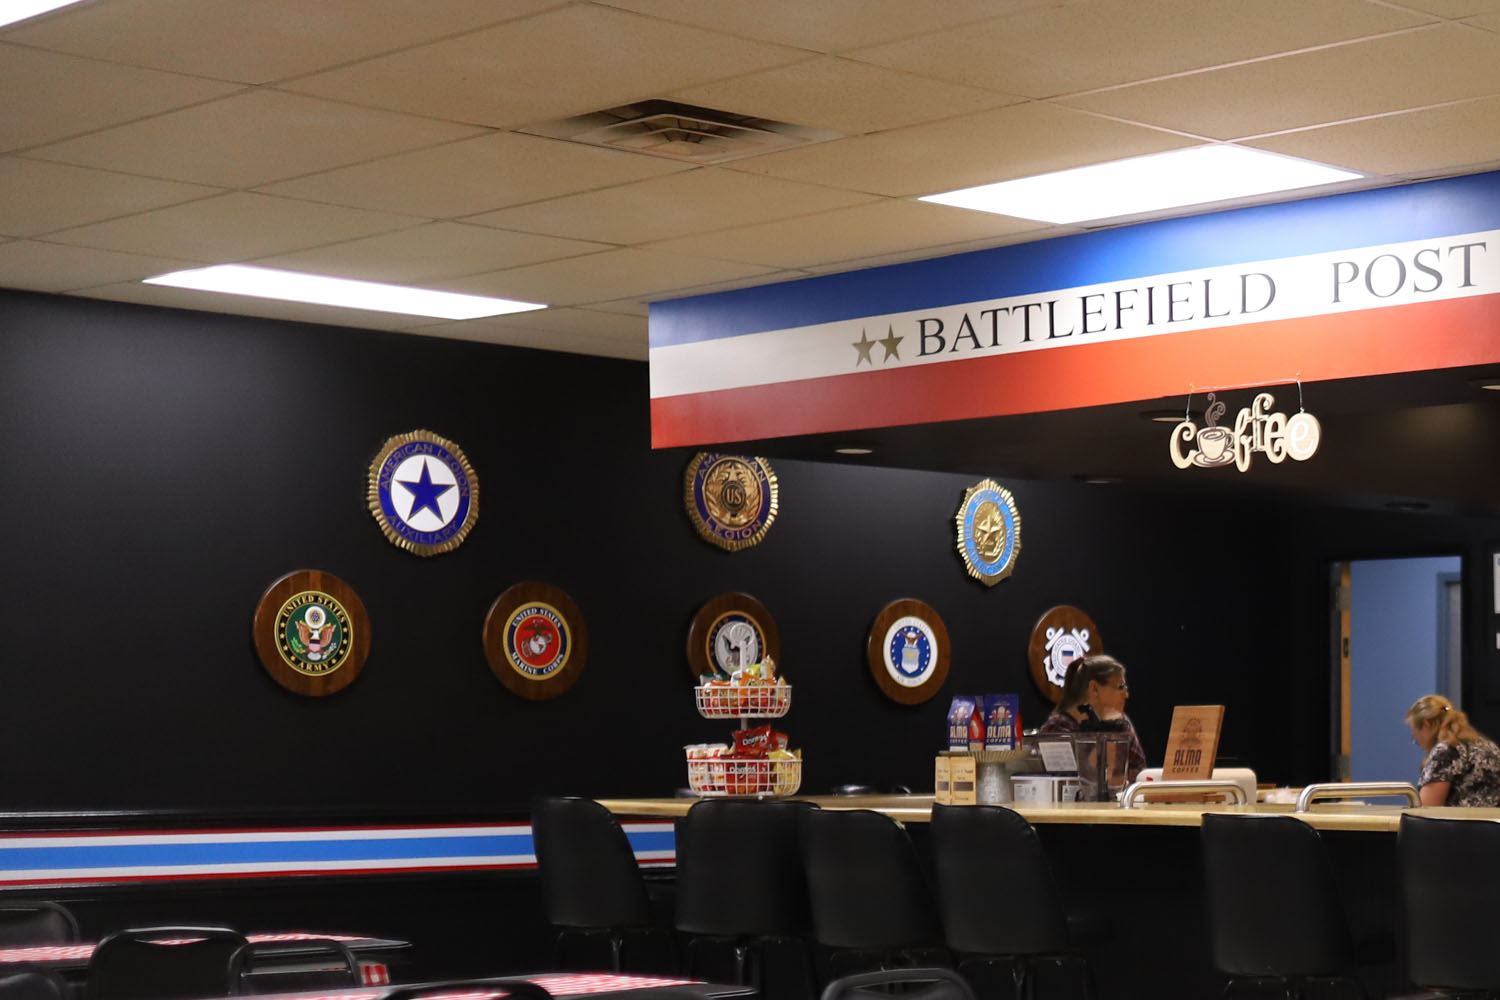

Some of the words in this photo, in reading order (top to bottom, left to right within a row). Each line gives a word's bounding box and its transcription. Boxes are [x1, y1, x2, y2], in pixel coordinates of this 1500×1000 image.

[916, 272, 1276, 357] BATTLEFIELD
[1331, 241, 1487, 304] POST
[380, 442, 433, 490] AMERICAN
[437, 449, 470, 497] LEGION
[387, 515, 460, 546] AUXILIARY
[705, 517, 762, 540] LEGION
[282, 595, 315, 618] UNITED
[318, 596, 345, 623] STATES
[297, 660, 330, 672] ARMY
[987, 725, 1011, 738] ALMA
[1173, 749, 1202, 766] ALMA
